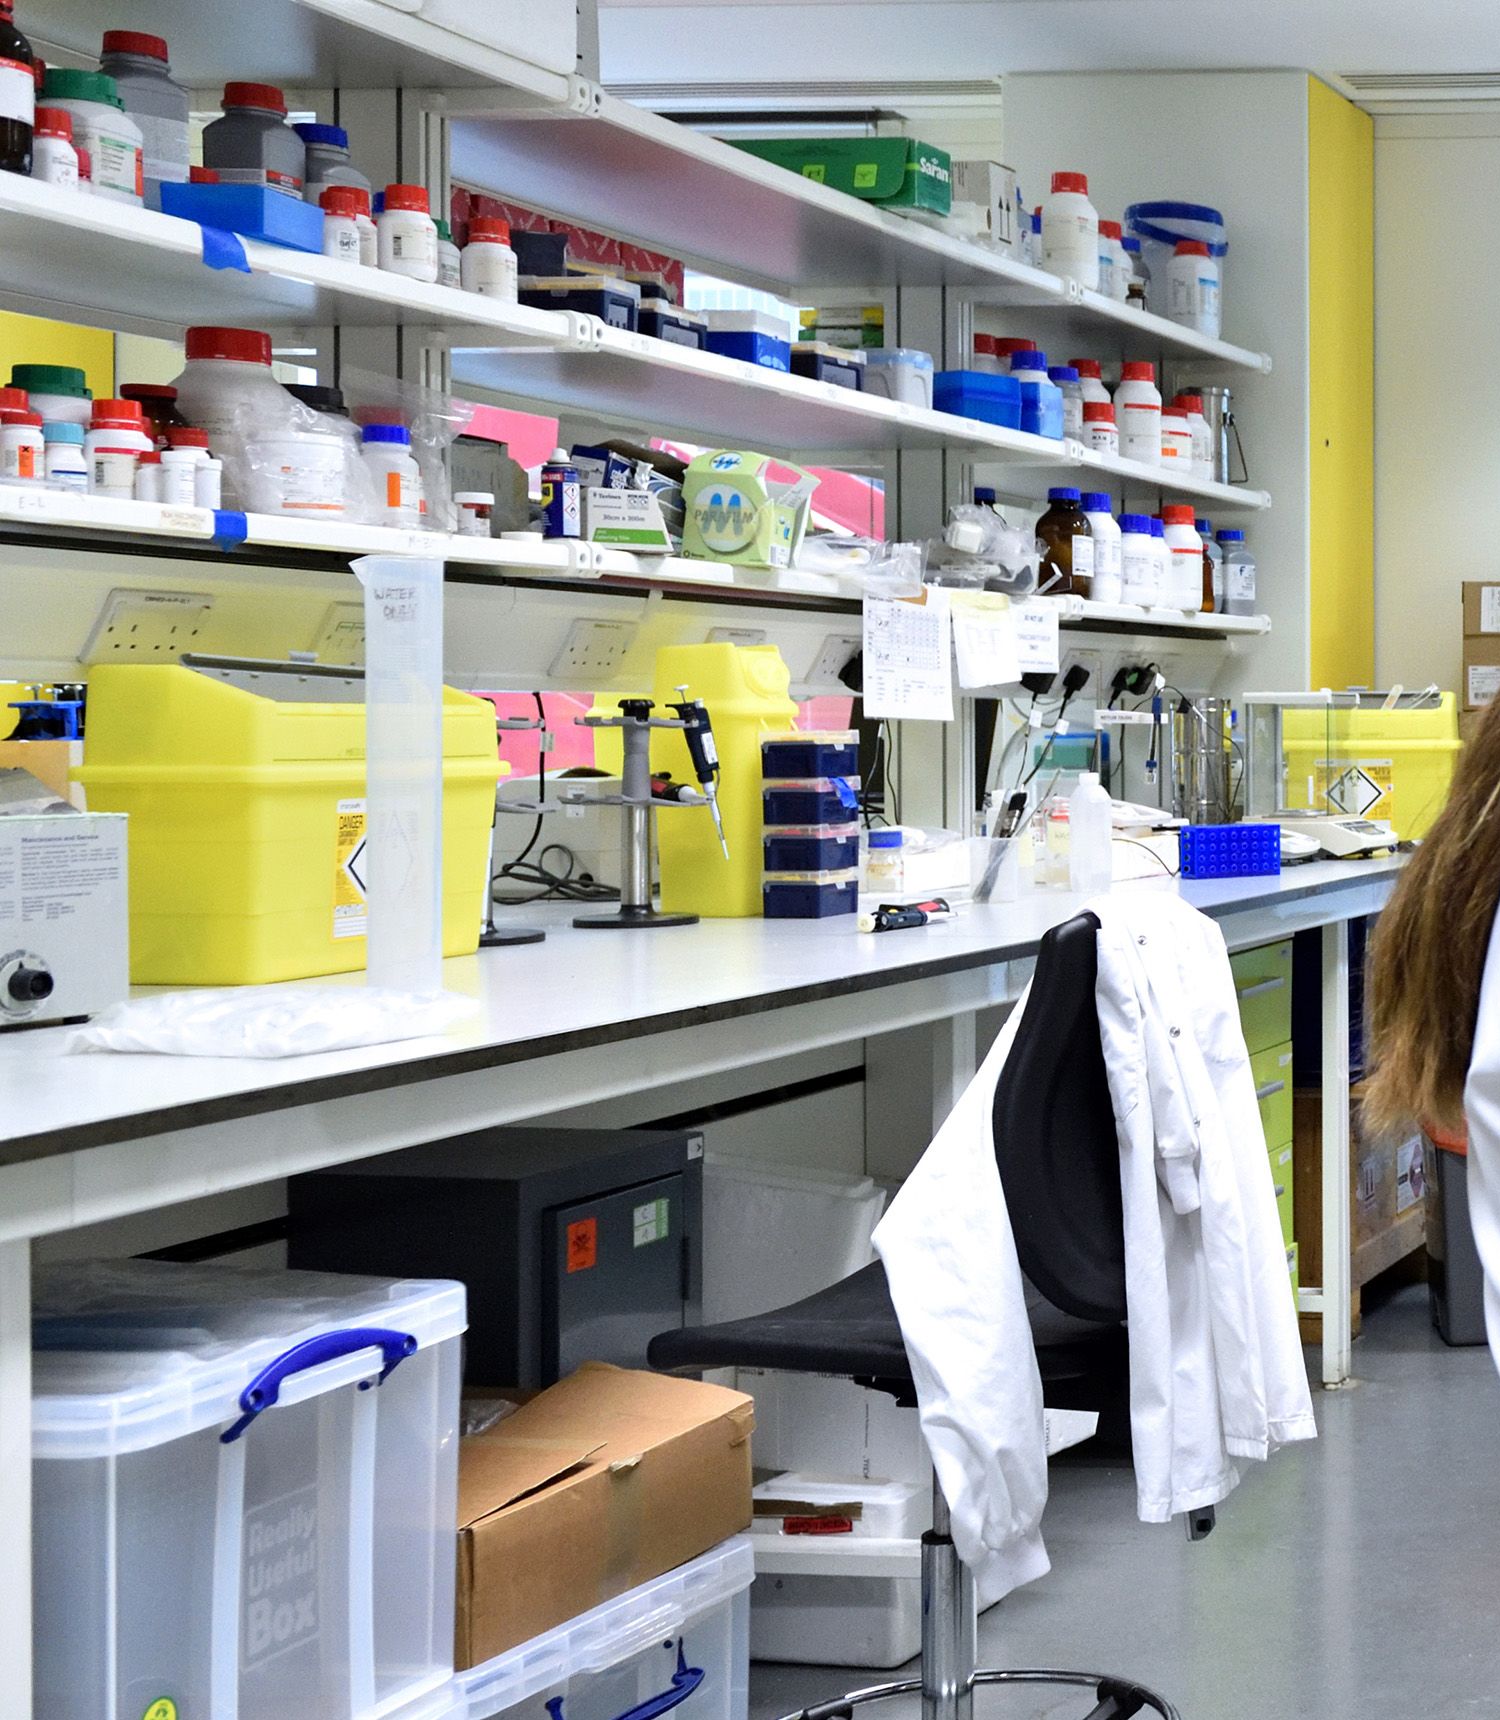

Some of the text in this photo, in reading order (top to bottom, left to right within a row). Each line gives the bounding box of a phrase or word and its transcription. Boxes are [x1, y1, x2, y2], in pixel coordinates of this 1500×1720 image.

[919, 157, 949, 182] Saran
[694, 508, 753, 525] PARAFILM
[373, 586, 417, 600] WATER
[339, 815, 363, 830] DANGER
[248, 1504, 316, 1557] Really
[248, 1541, 315, 1597] Useful
[247, 1590, 316, 1658] Box
